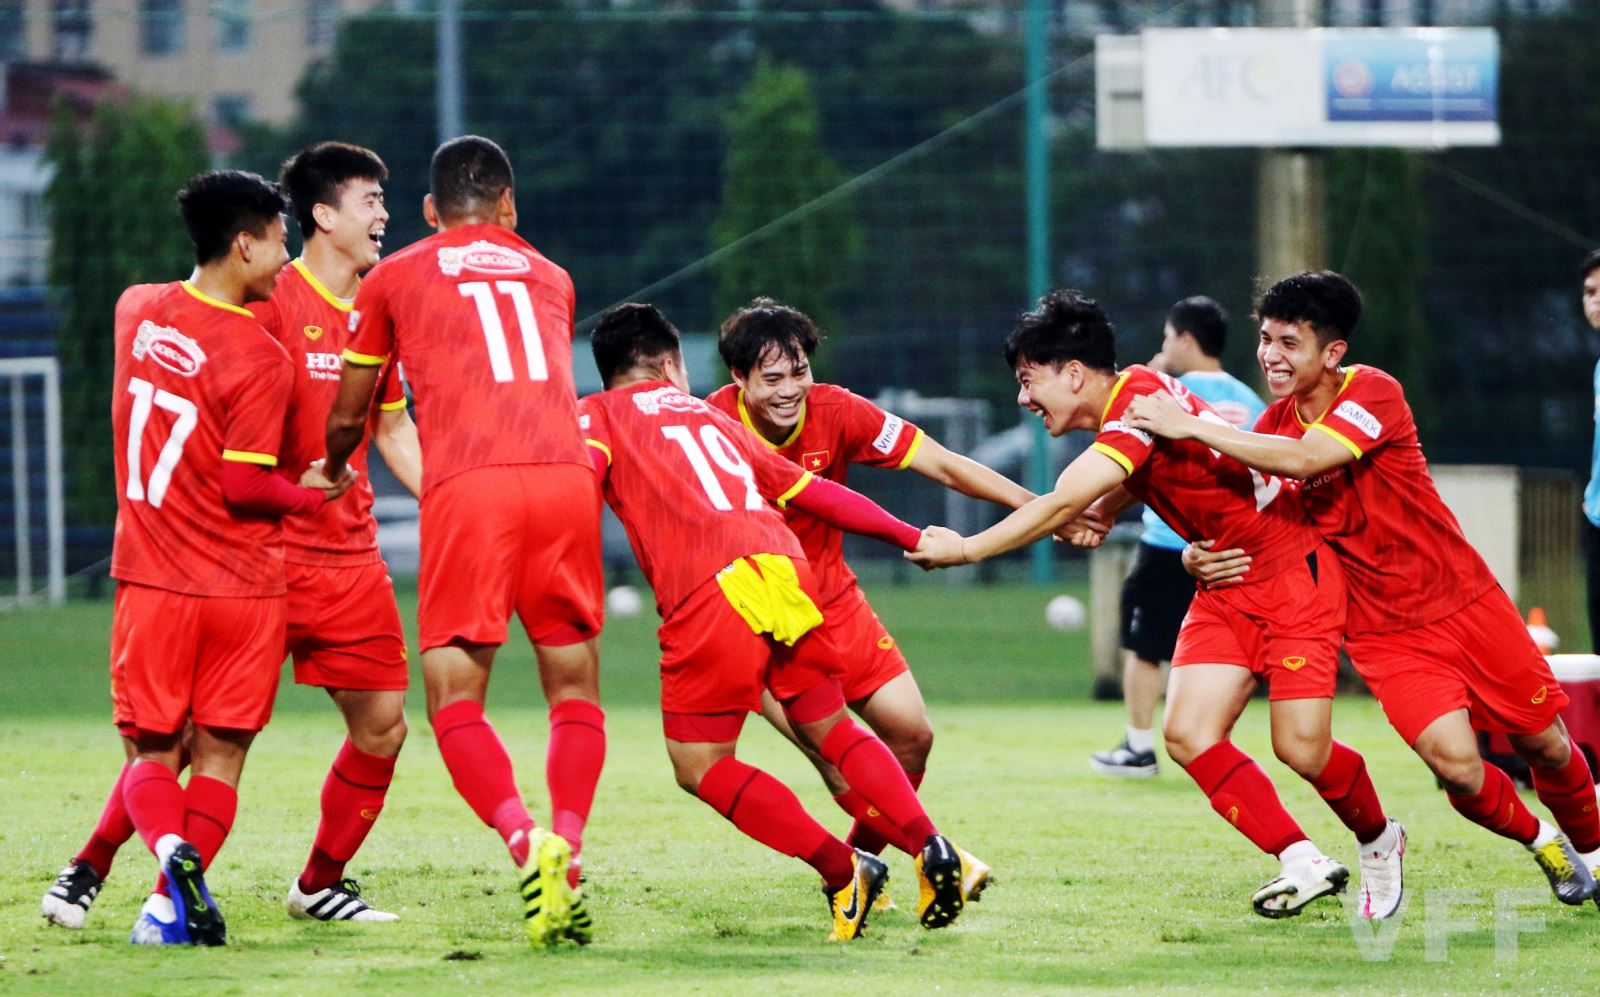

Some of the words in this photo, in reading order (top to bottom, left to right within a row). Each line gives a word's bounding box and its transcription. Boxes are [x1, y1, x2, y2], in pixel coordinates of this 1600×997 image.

[457, 280, 549, 382] 11
[126, 377, 198, 508] 17
[660, 424, 763, 511] 19
